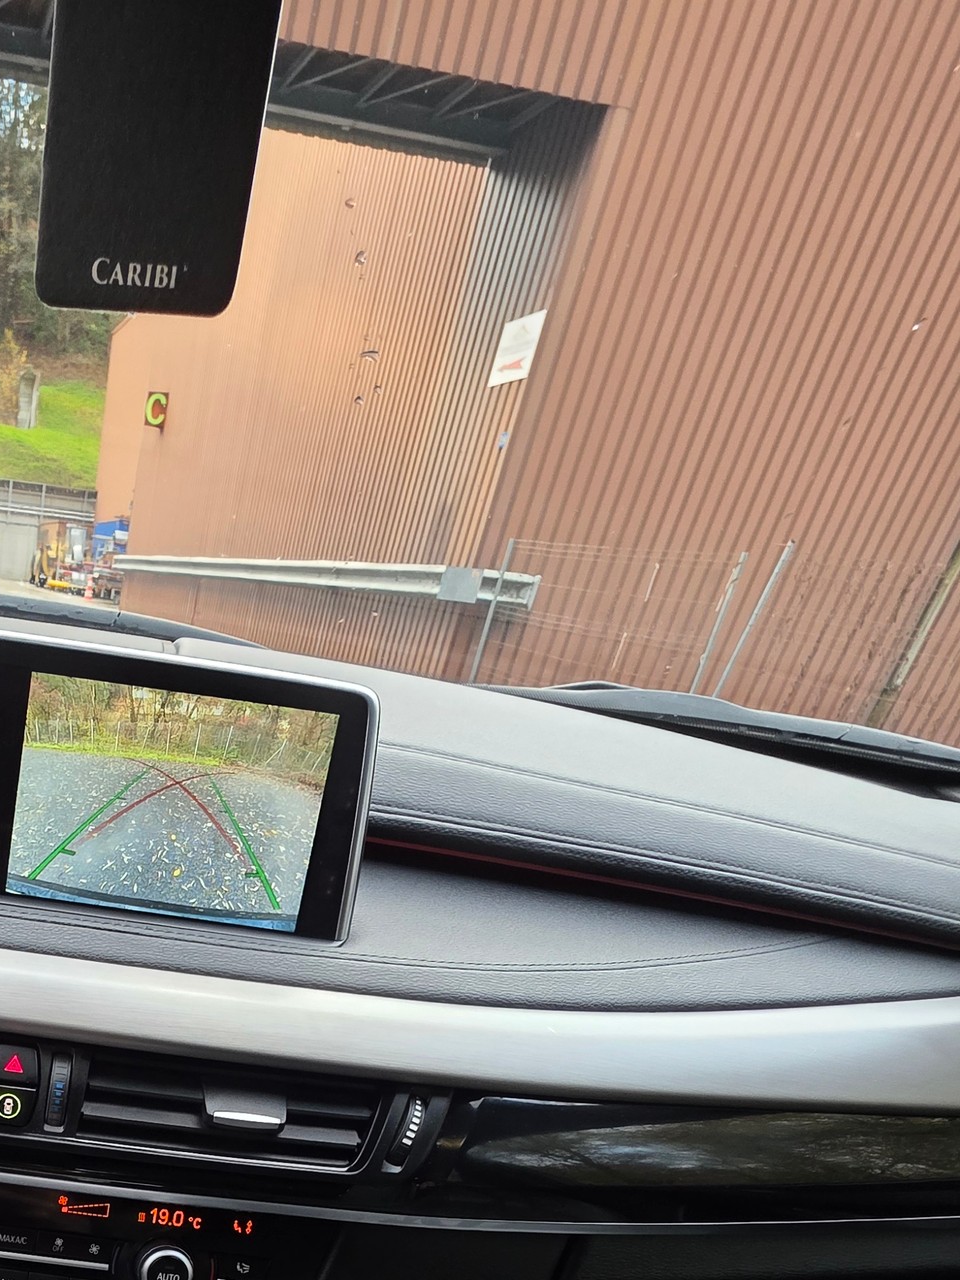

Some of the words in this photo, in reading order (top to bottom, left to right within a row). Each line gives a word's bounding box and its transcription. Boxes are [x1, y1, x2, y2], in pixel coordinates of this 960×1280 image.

[91, 257, 178, 289] CARIBI
[145, 392, 167, 425] C
[149, 1207, 184, 1227] 19.0
[15, 1236, 28, 1245] A/C
